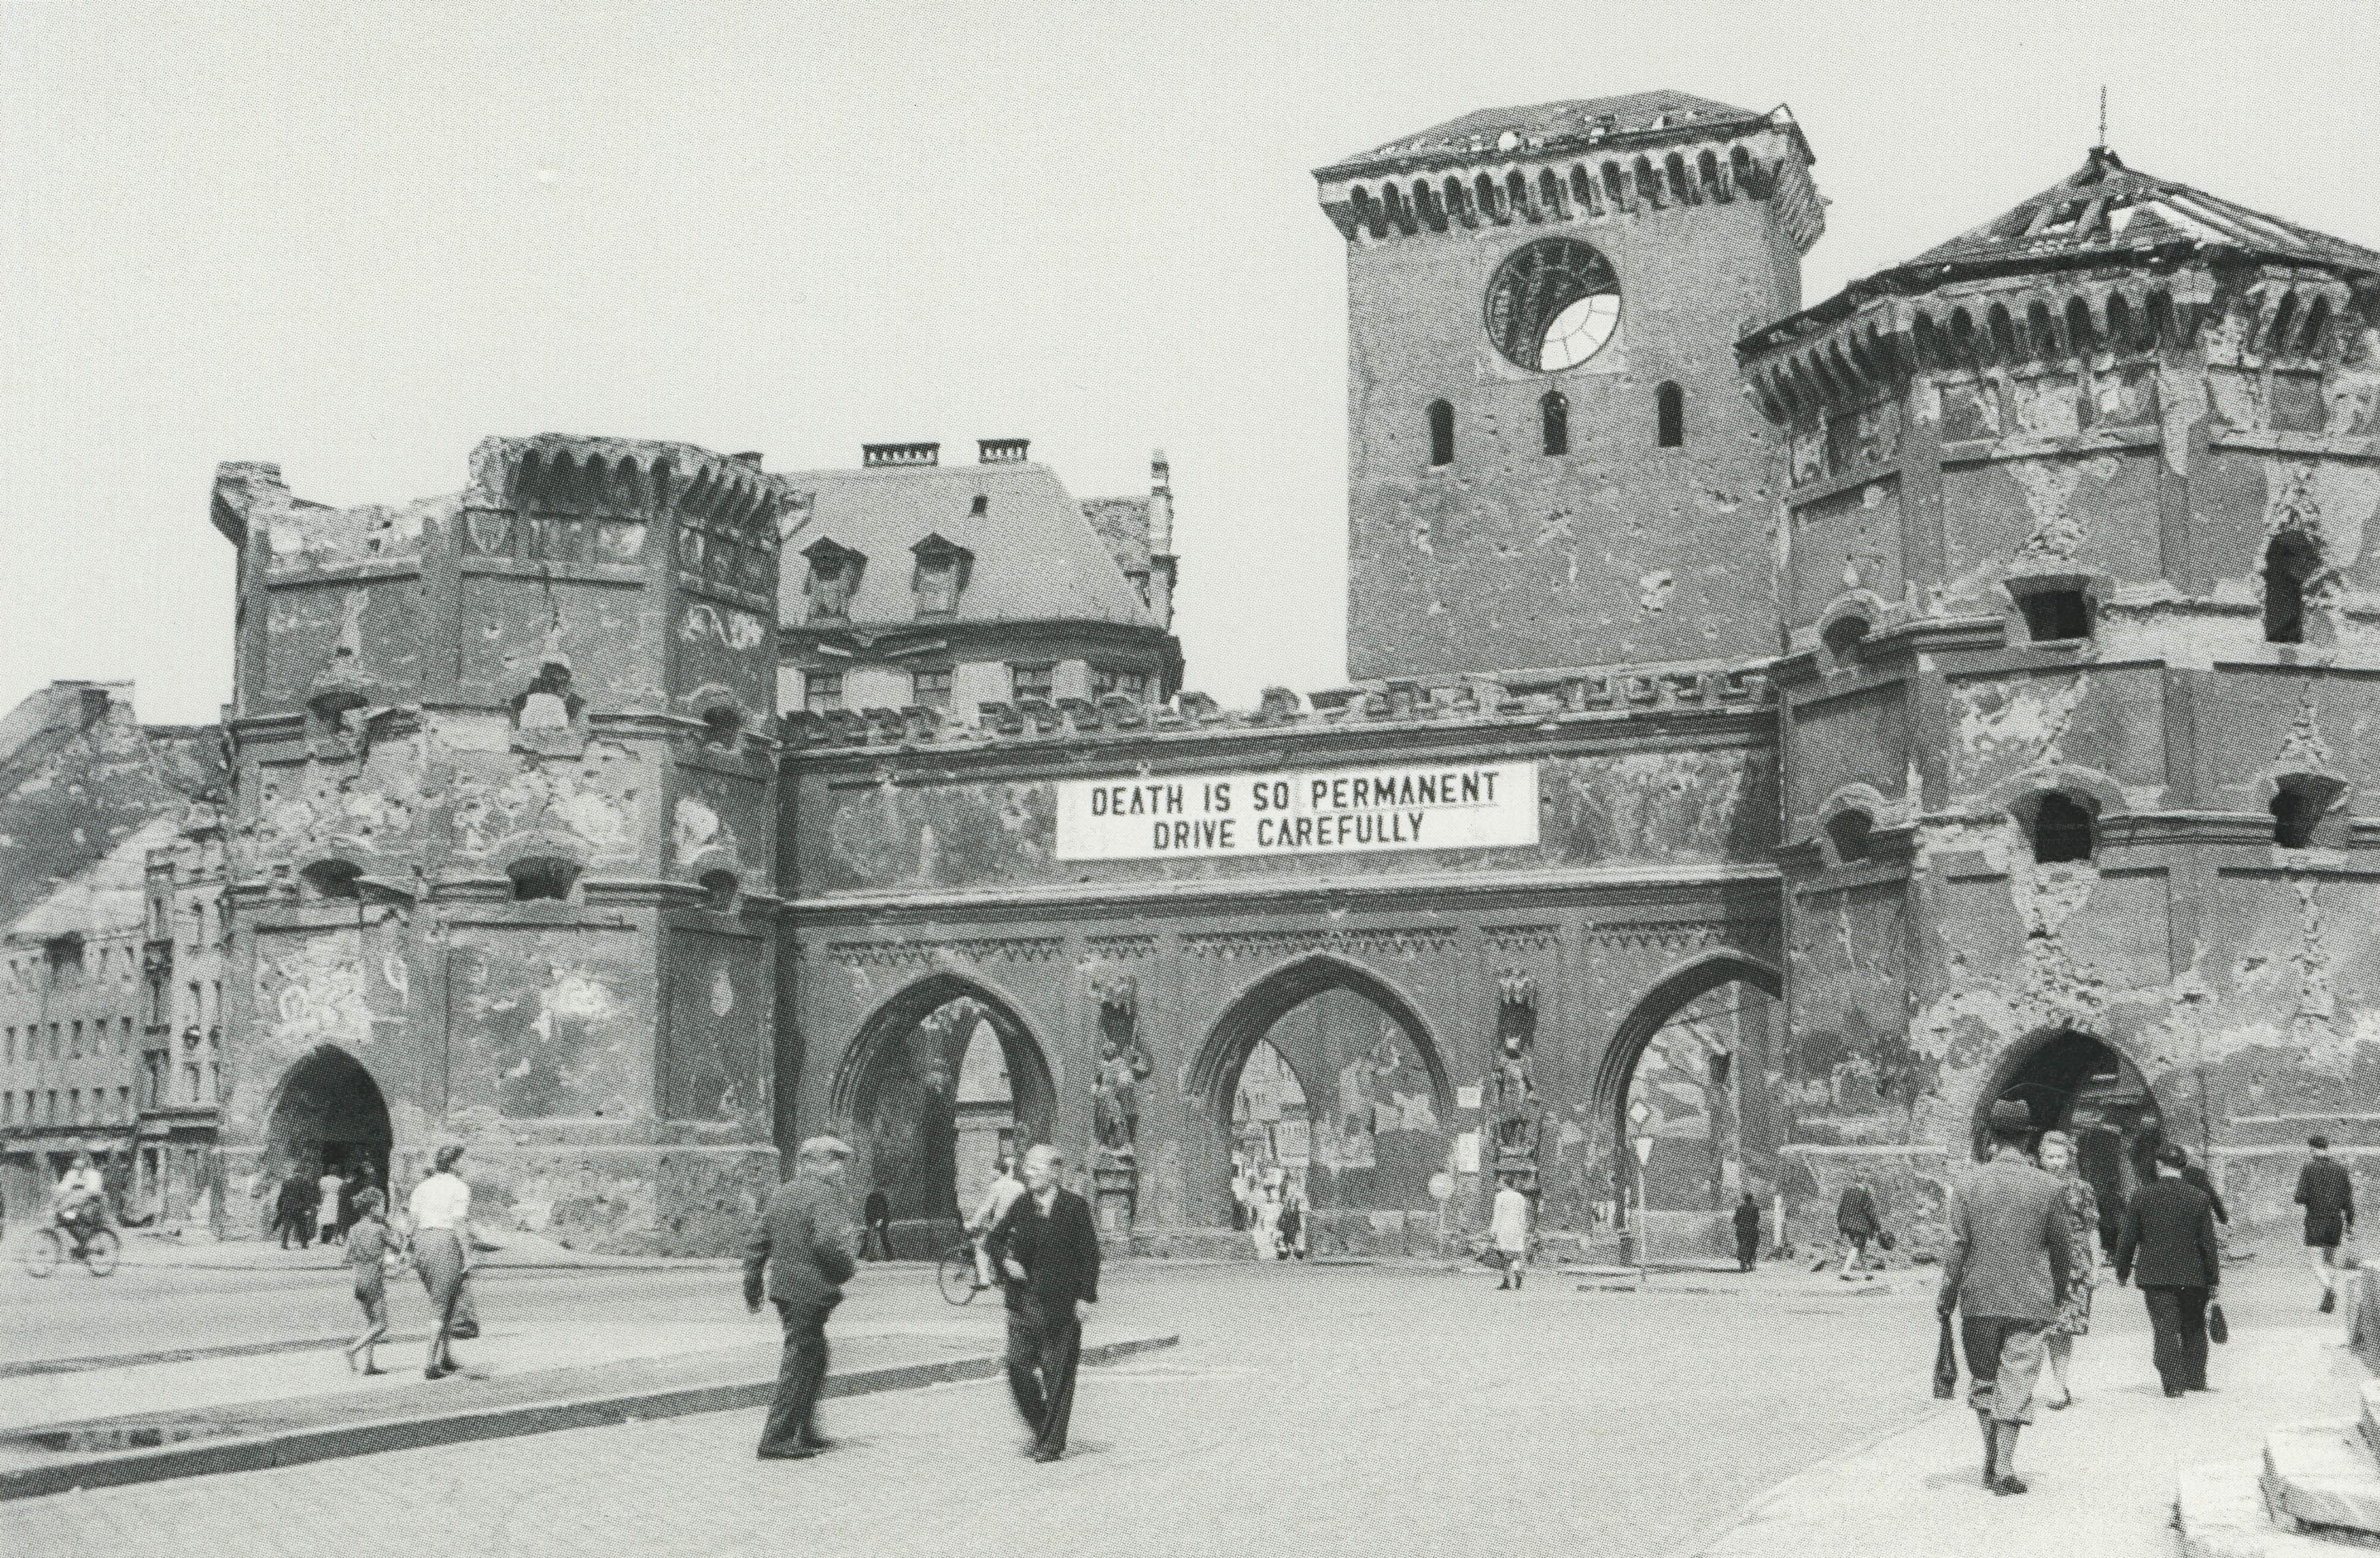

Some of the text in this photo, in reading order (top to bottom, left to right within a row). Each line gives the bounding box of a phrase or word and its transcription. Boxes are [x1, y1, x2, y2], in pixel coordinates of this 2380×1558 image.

[1091, 771, 1499, 817] DEATH IS SO PERMANENT
[1154, 813, 1424, 850] DRIVE CAREFULLY
